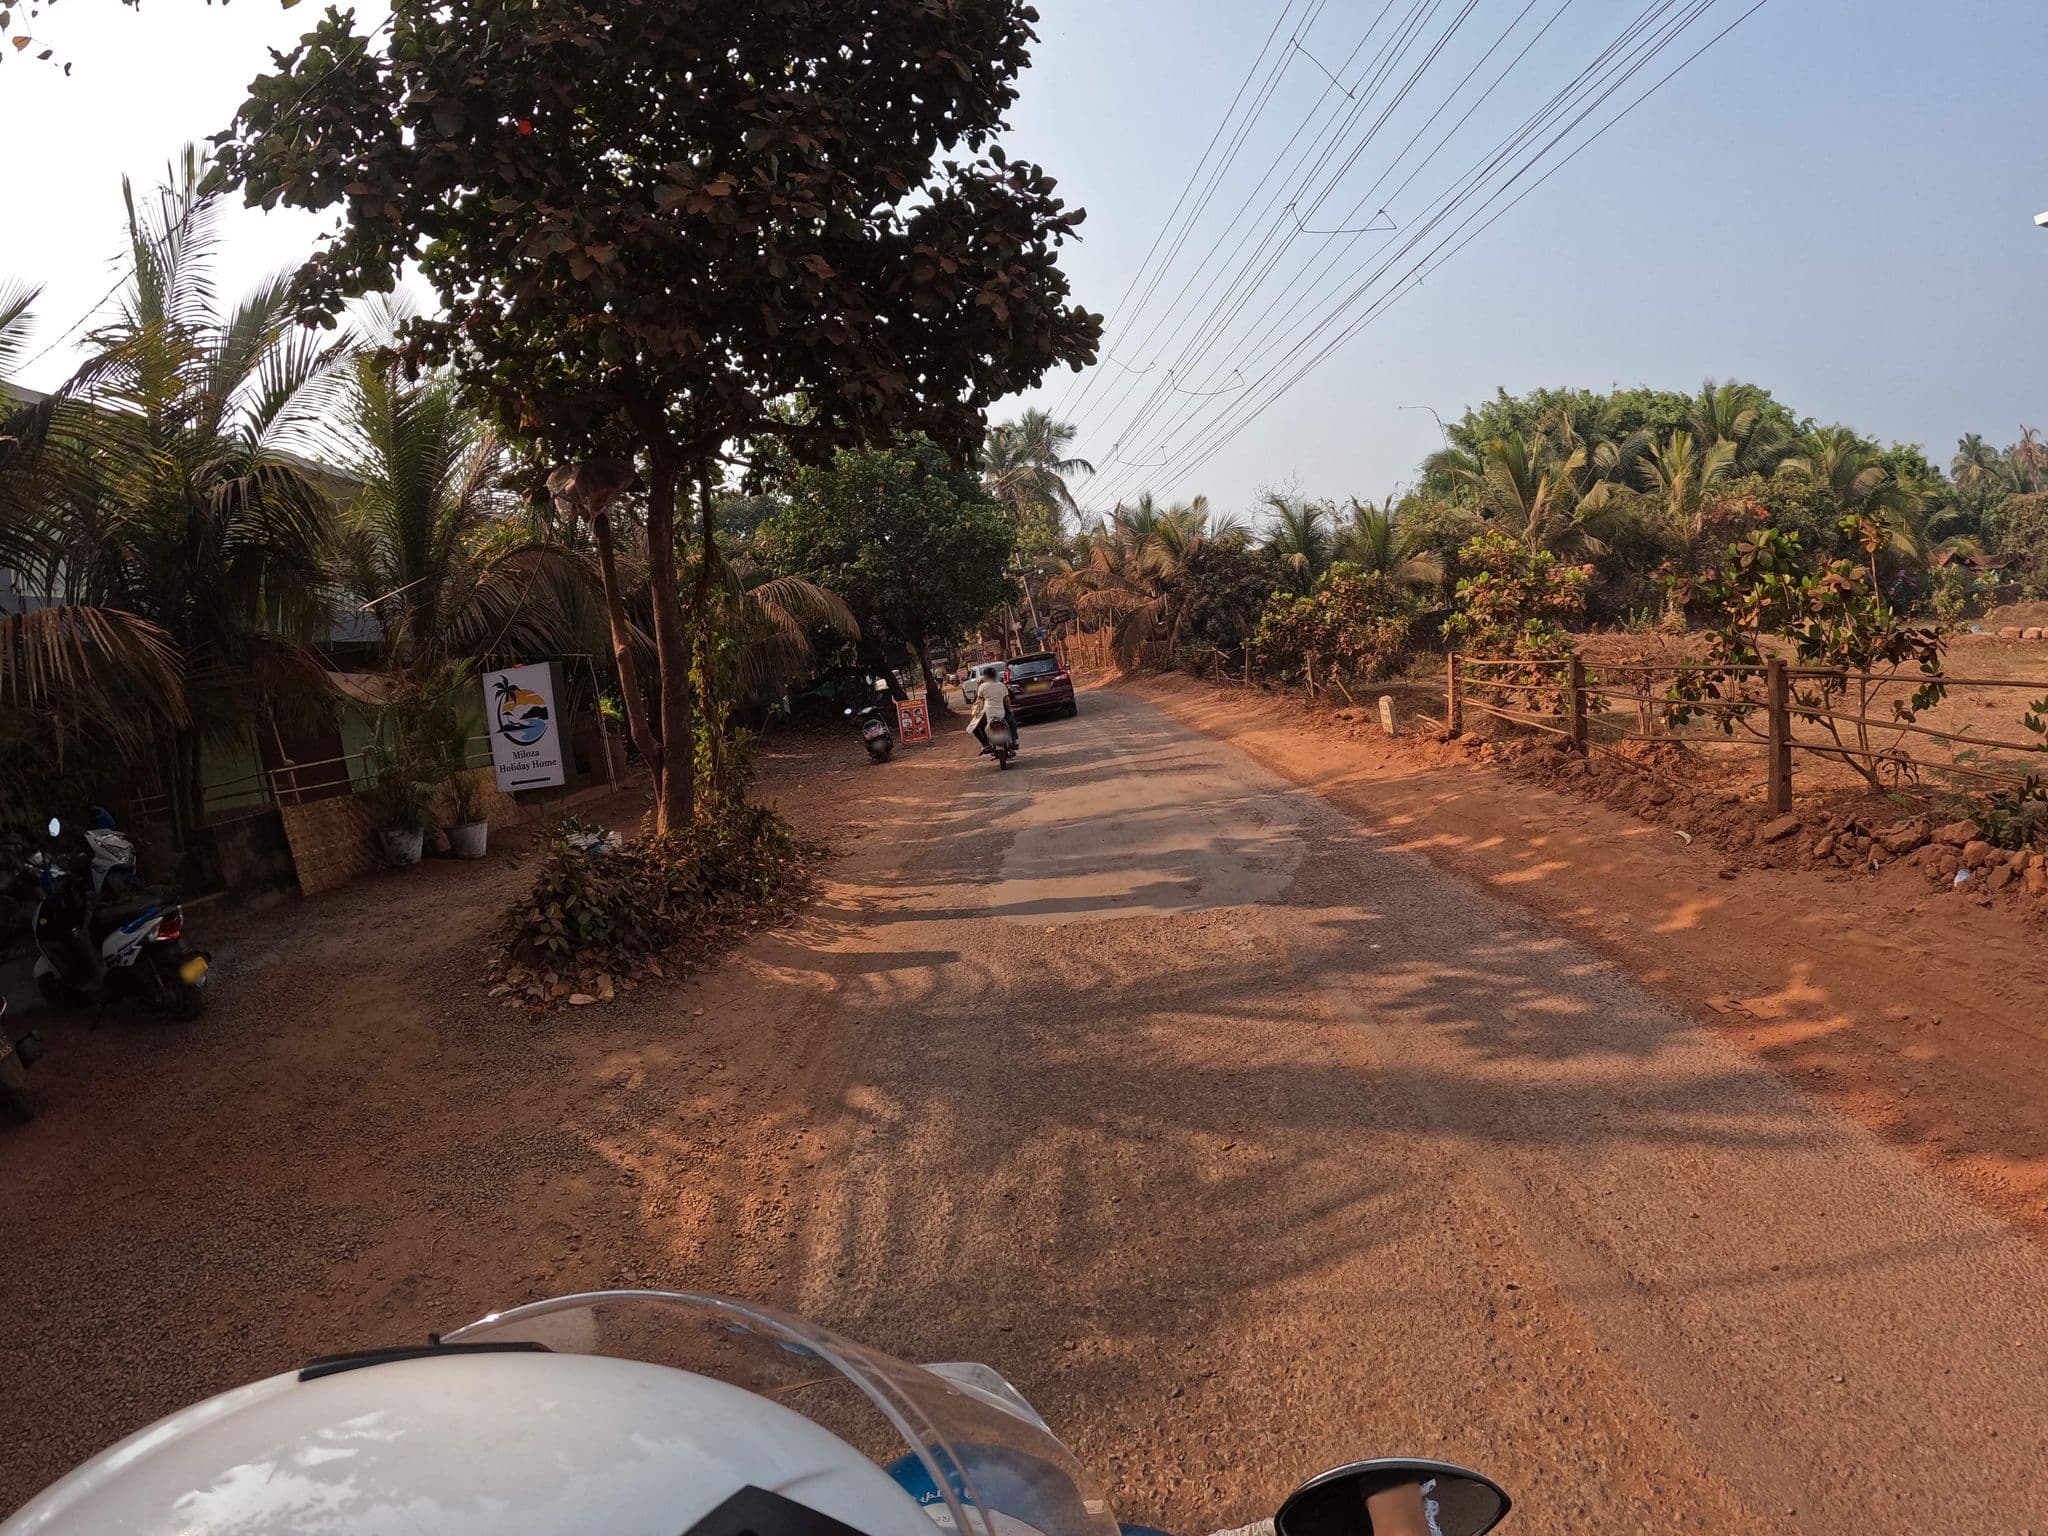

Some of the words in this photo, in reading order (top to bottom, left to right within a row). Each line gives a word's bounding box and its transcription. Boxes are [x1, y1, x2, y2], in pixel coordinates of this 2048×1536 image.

[512, 749, 540, 760] Miloza
[499, 762, 530, 773] Holiday
[532, 759, 557, 769] Home
